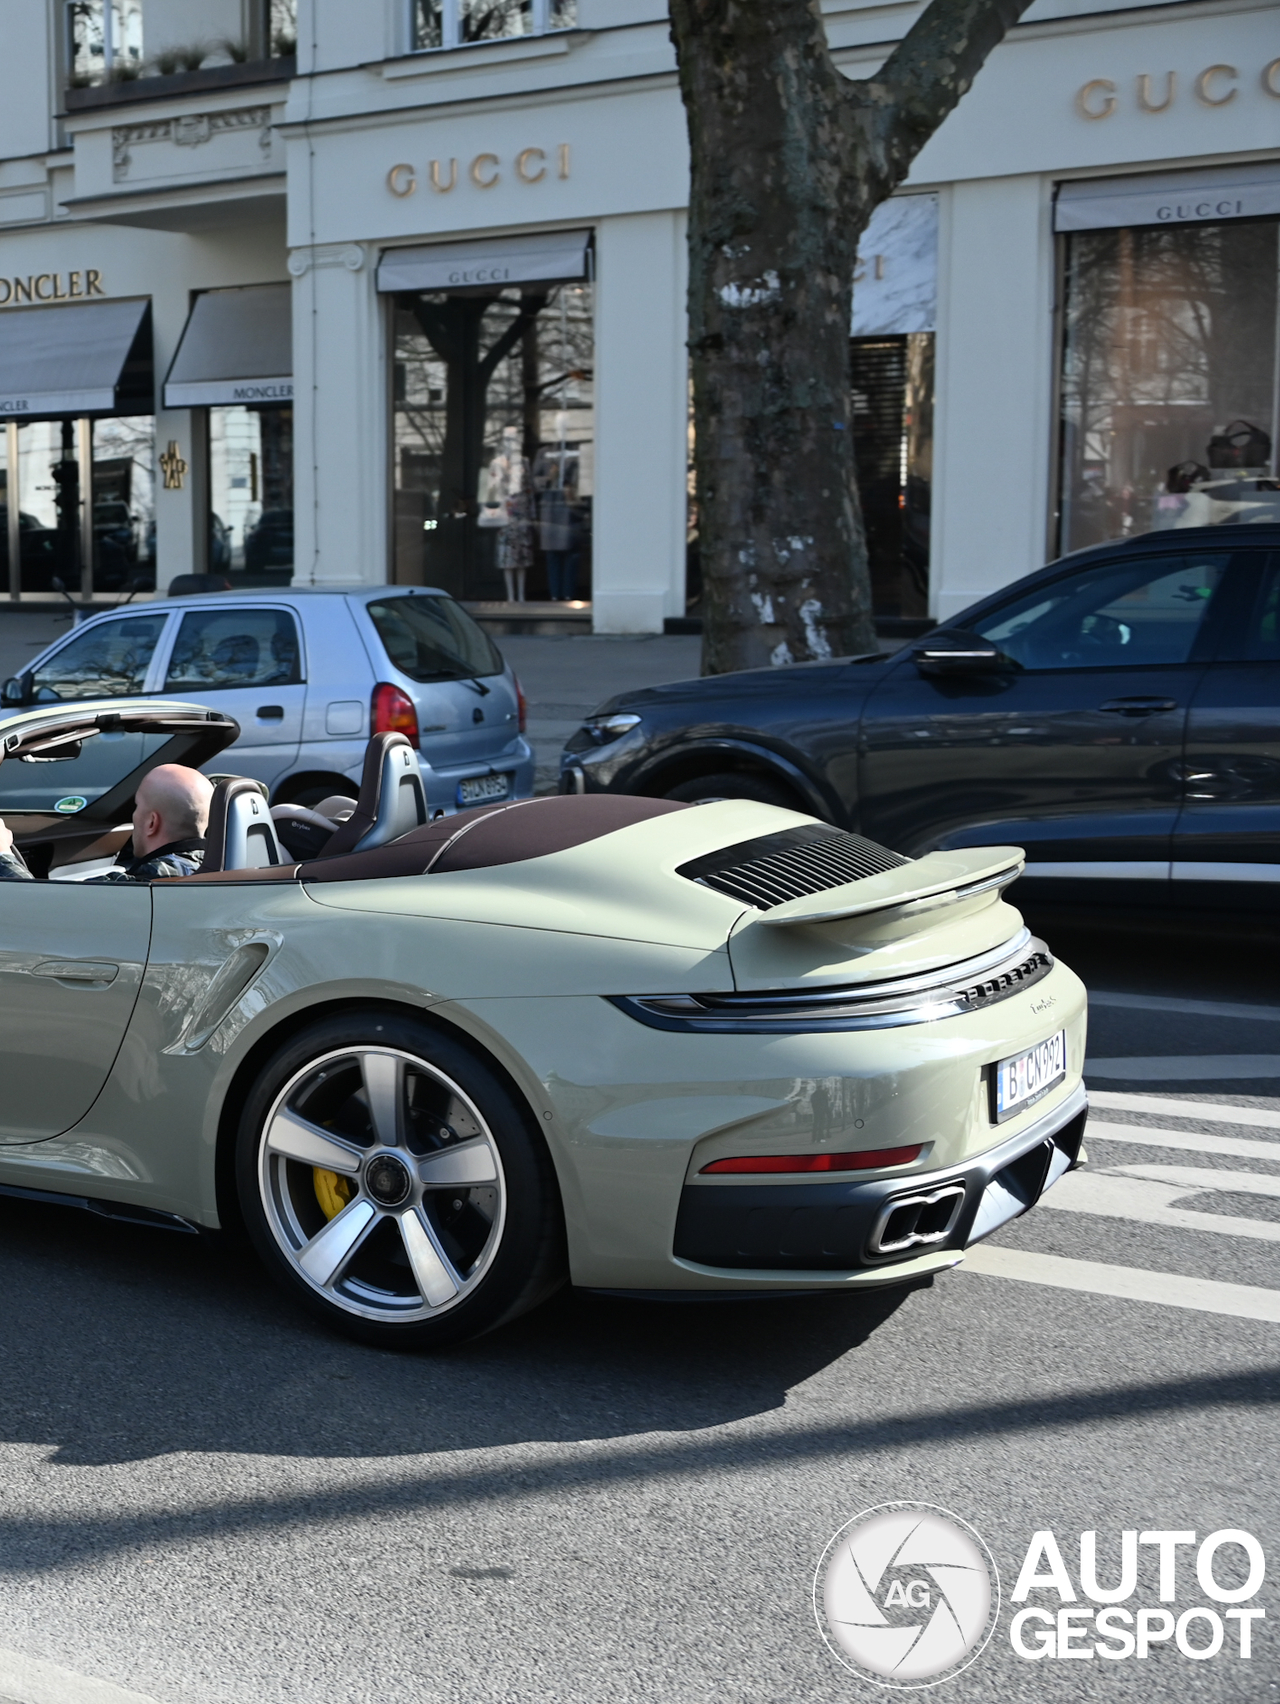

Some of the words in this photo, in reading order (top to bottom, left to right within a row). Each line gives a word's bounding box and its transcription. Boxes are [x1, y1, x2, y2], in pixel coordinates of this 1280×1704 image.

[386, 143, 570, 198] GUCCI
[1156, 200, 1243, 221] GUCCI
[448, 267, 510, 284] GUCCI
[233, 385, 294, 399] MONCLER
[966, 955, 1041, 1003] PORSCHE
[1009, 1061, 1017, 1100] B
